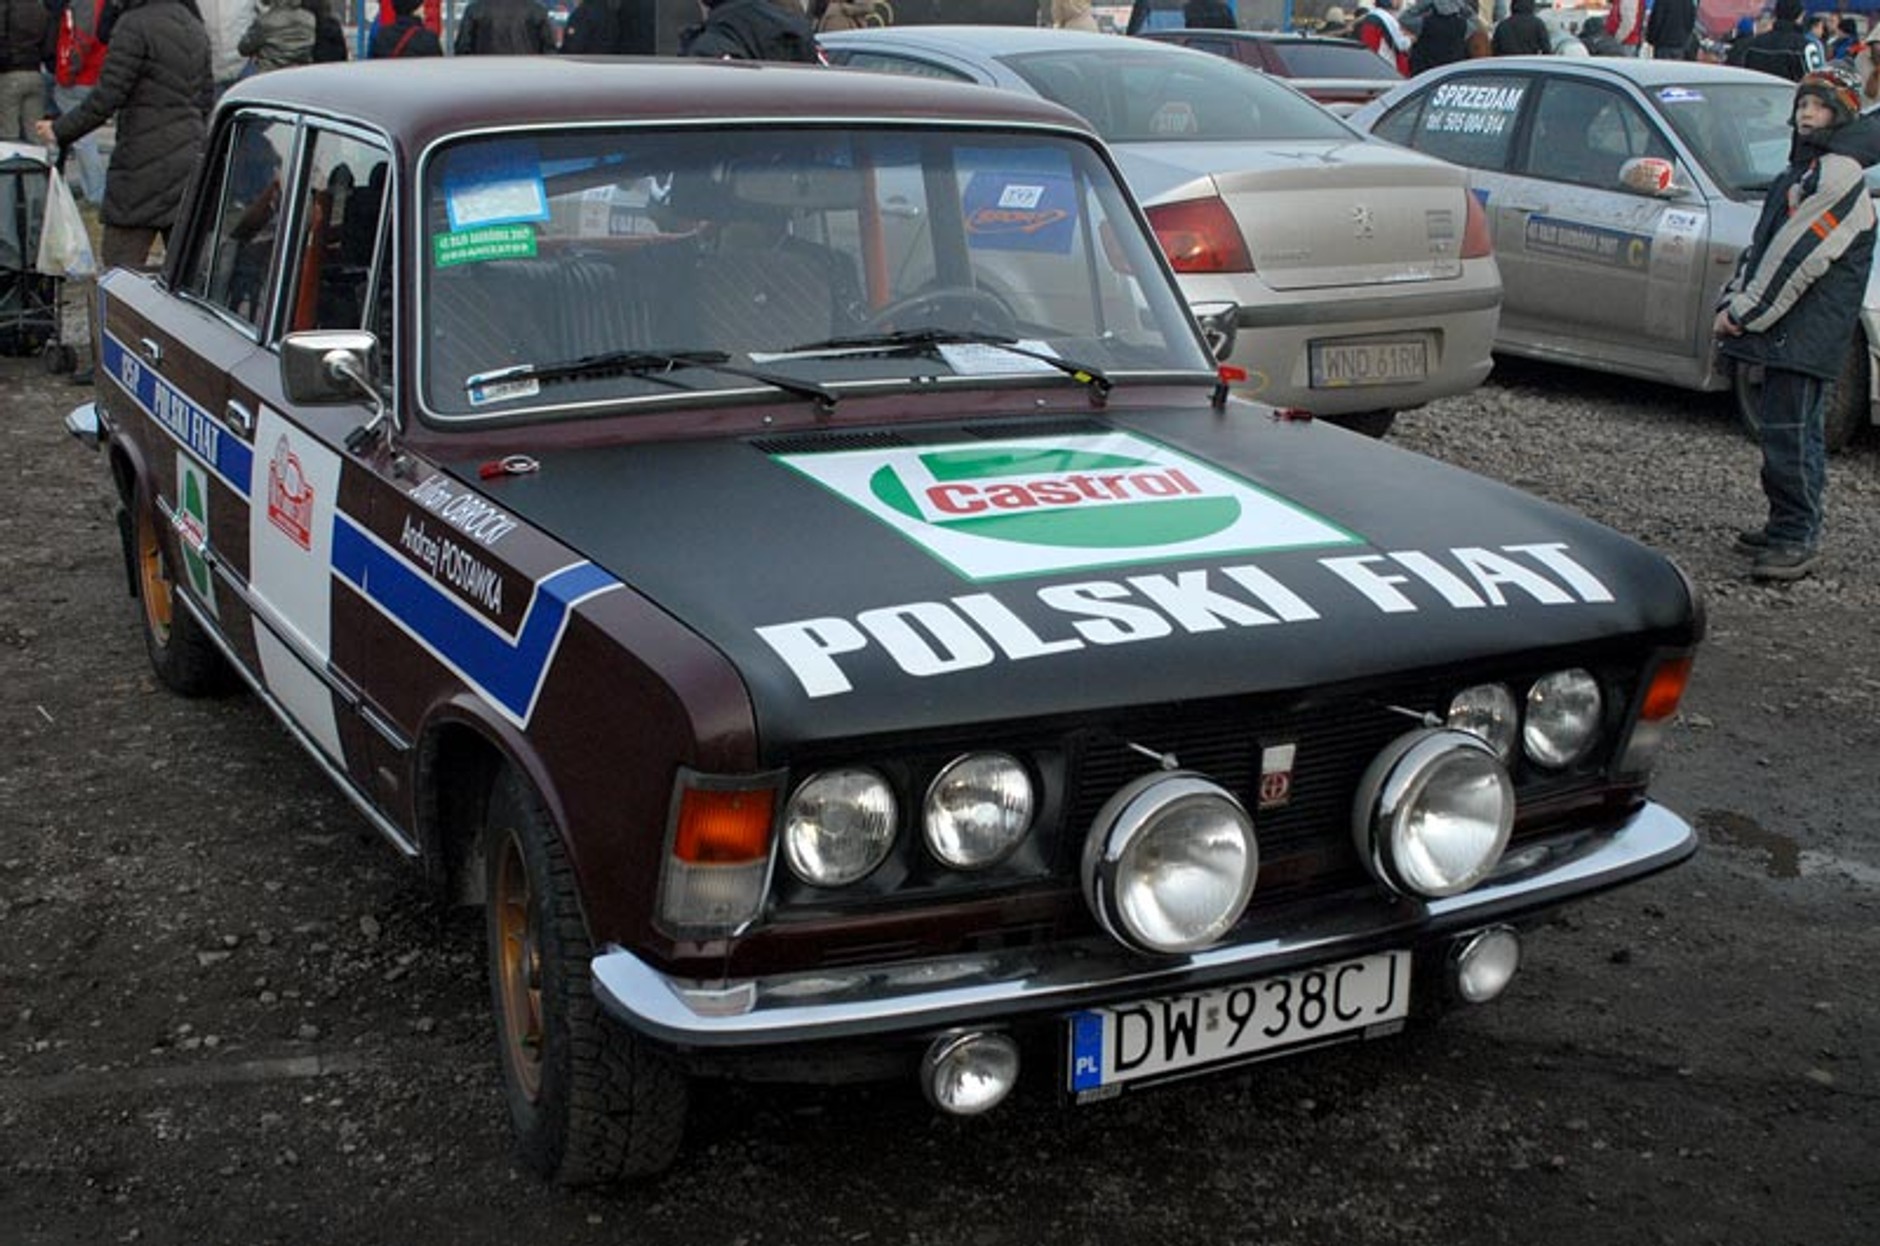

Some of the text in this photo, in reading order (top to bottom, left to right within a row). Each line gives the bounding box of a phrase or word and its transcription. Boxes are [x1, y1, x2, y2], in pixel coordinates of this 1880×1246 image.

[1432, 84, 1524, 111] SPRZEDAM
[1325, 347, 1369, 378] WND
[155, 380, 190, 442] POLSKI
[192, 410, 219, 467] FIAT
[924, 468, 1204, 515] Castrol
[400, 514, 502, 615] Andrzej POSTAWKA
[754, 542, 1616, 698] POLSKI FIAT
[1076, 954, 1398, 1076] PL DW 938CJ
